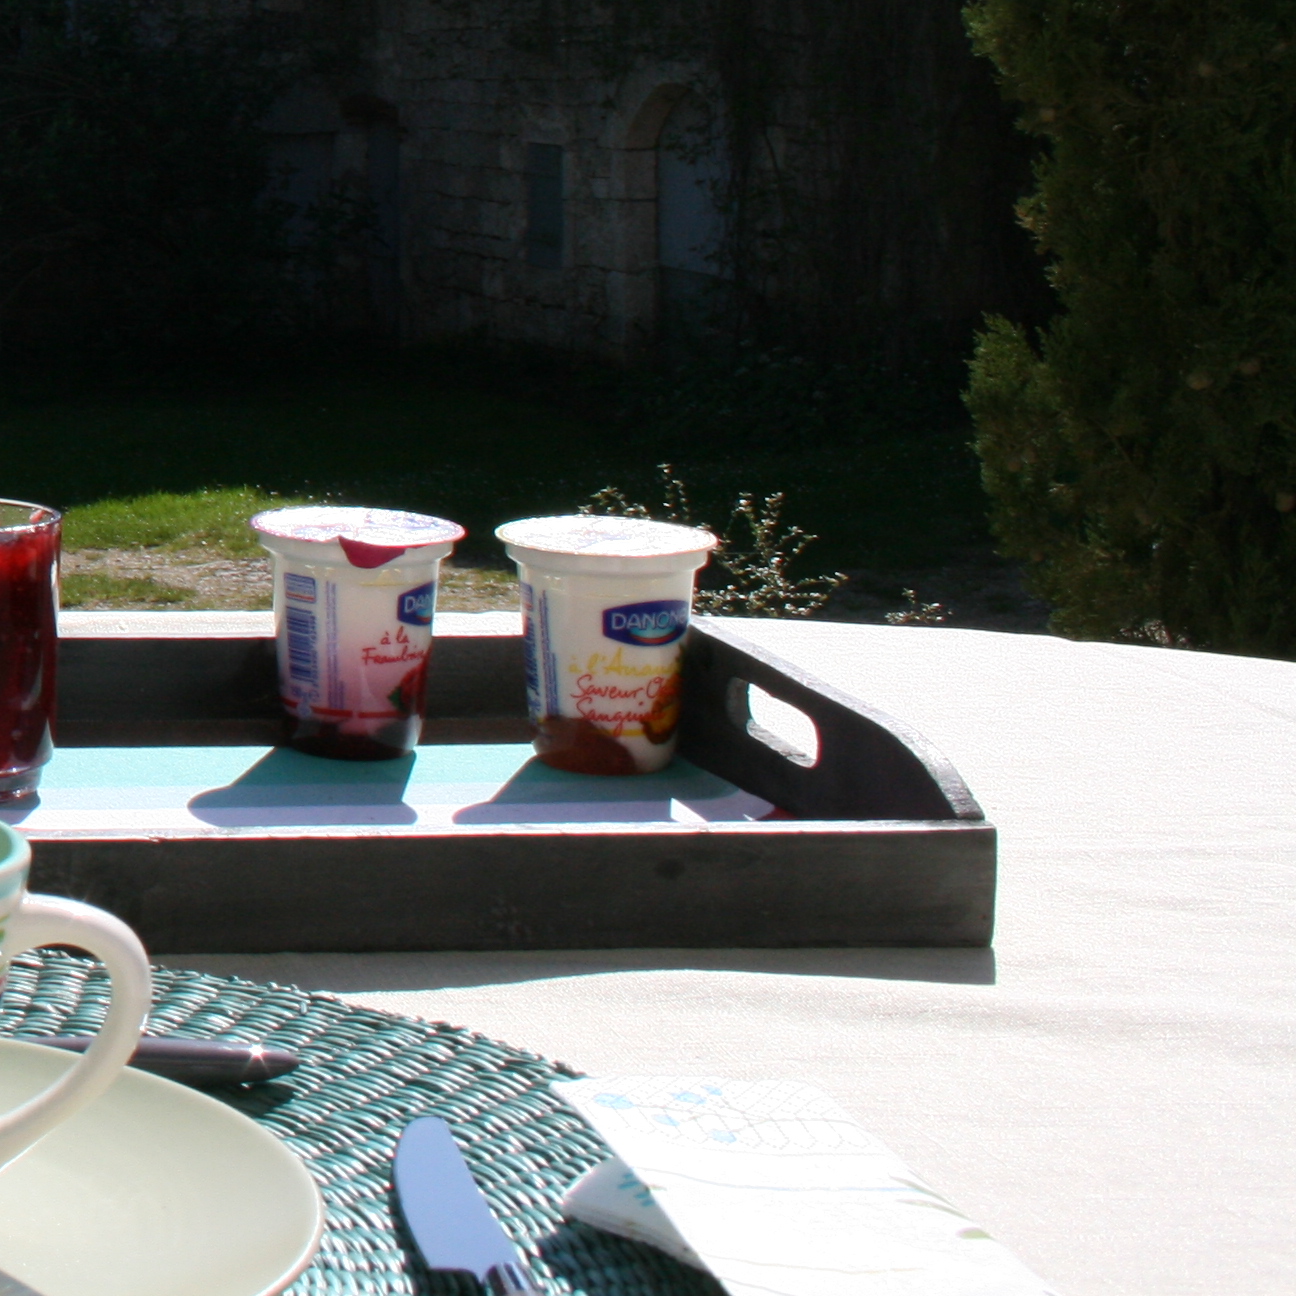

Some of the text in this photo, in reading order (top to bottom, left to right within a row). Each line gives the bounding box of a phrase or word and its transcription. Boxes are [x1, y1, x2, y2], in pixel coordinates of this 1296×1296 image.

[380, 625, 410, 645] à la
[570, 673, 644, 699] Saveur
